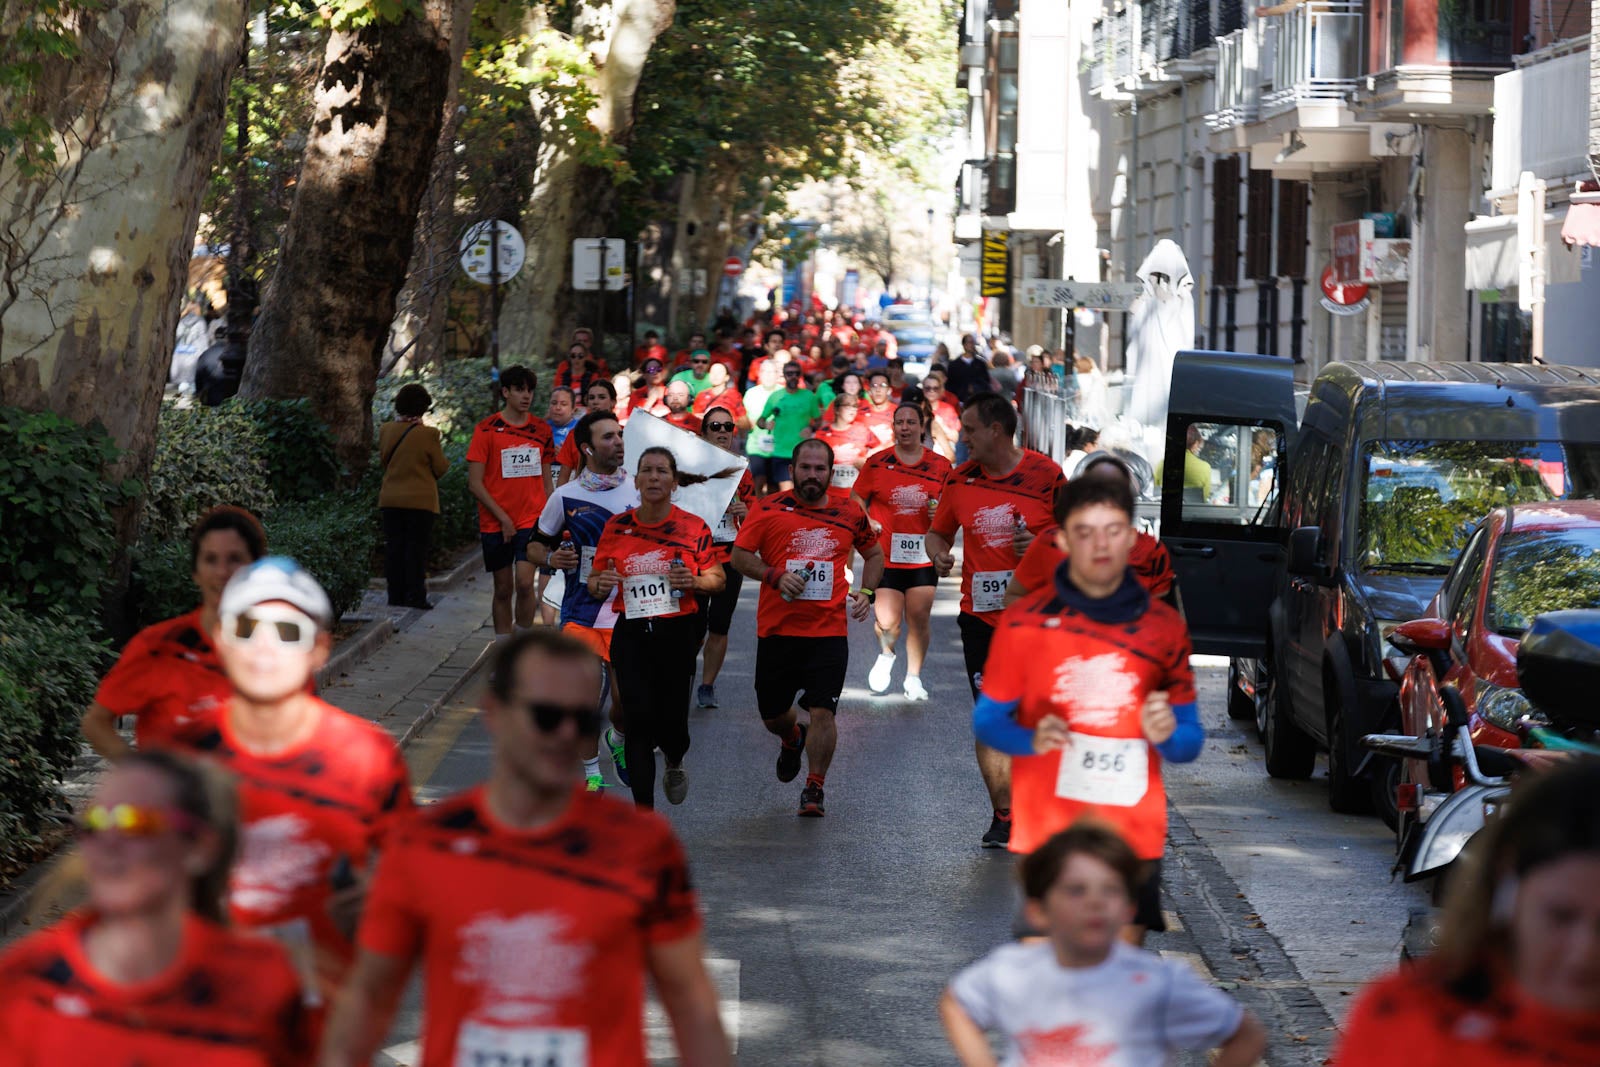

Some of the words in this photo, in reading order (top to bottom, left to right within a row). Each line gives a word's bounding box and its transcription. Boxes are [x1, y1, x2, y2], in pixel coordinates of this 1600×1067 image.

[511, 454, 531, 464] 734
[792, 537, 835, 548] carrera
[900, 540, 920, 550] 801
[625, 562, 671, 573] carrera
[630, 582, 665, 598] 1101
[982, 579, 1008, 593] 591
[1082, 751, 1126, 772] 856
